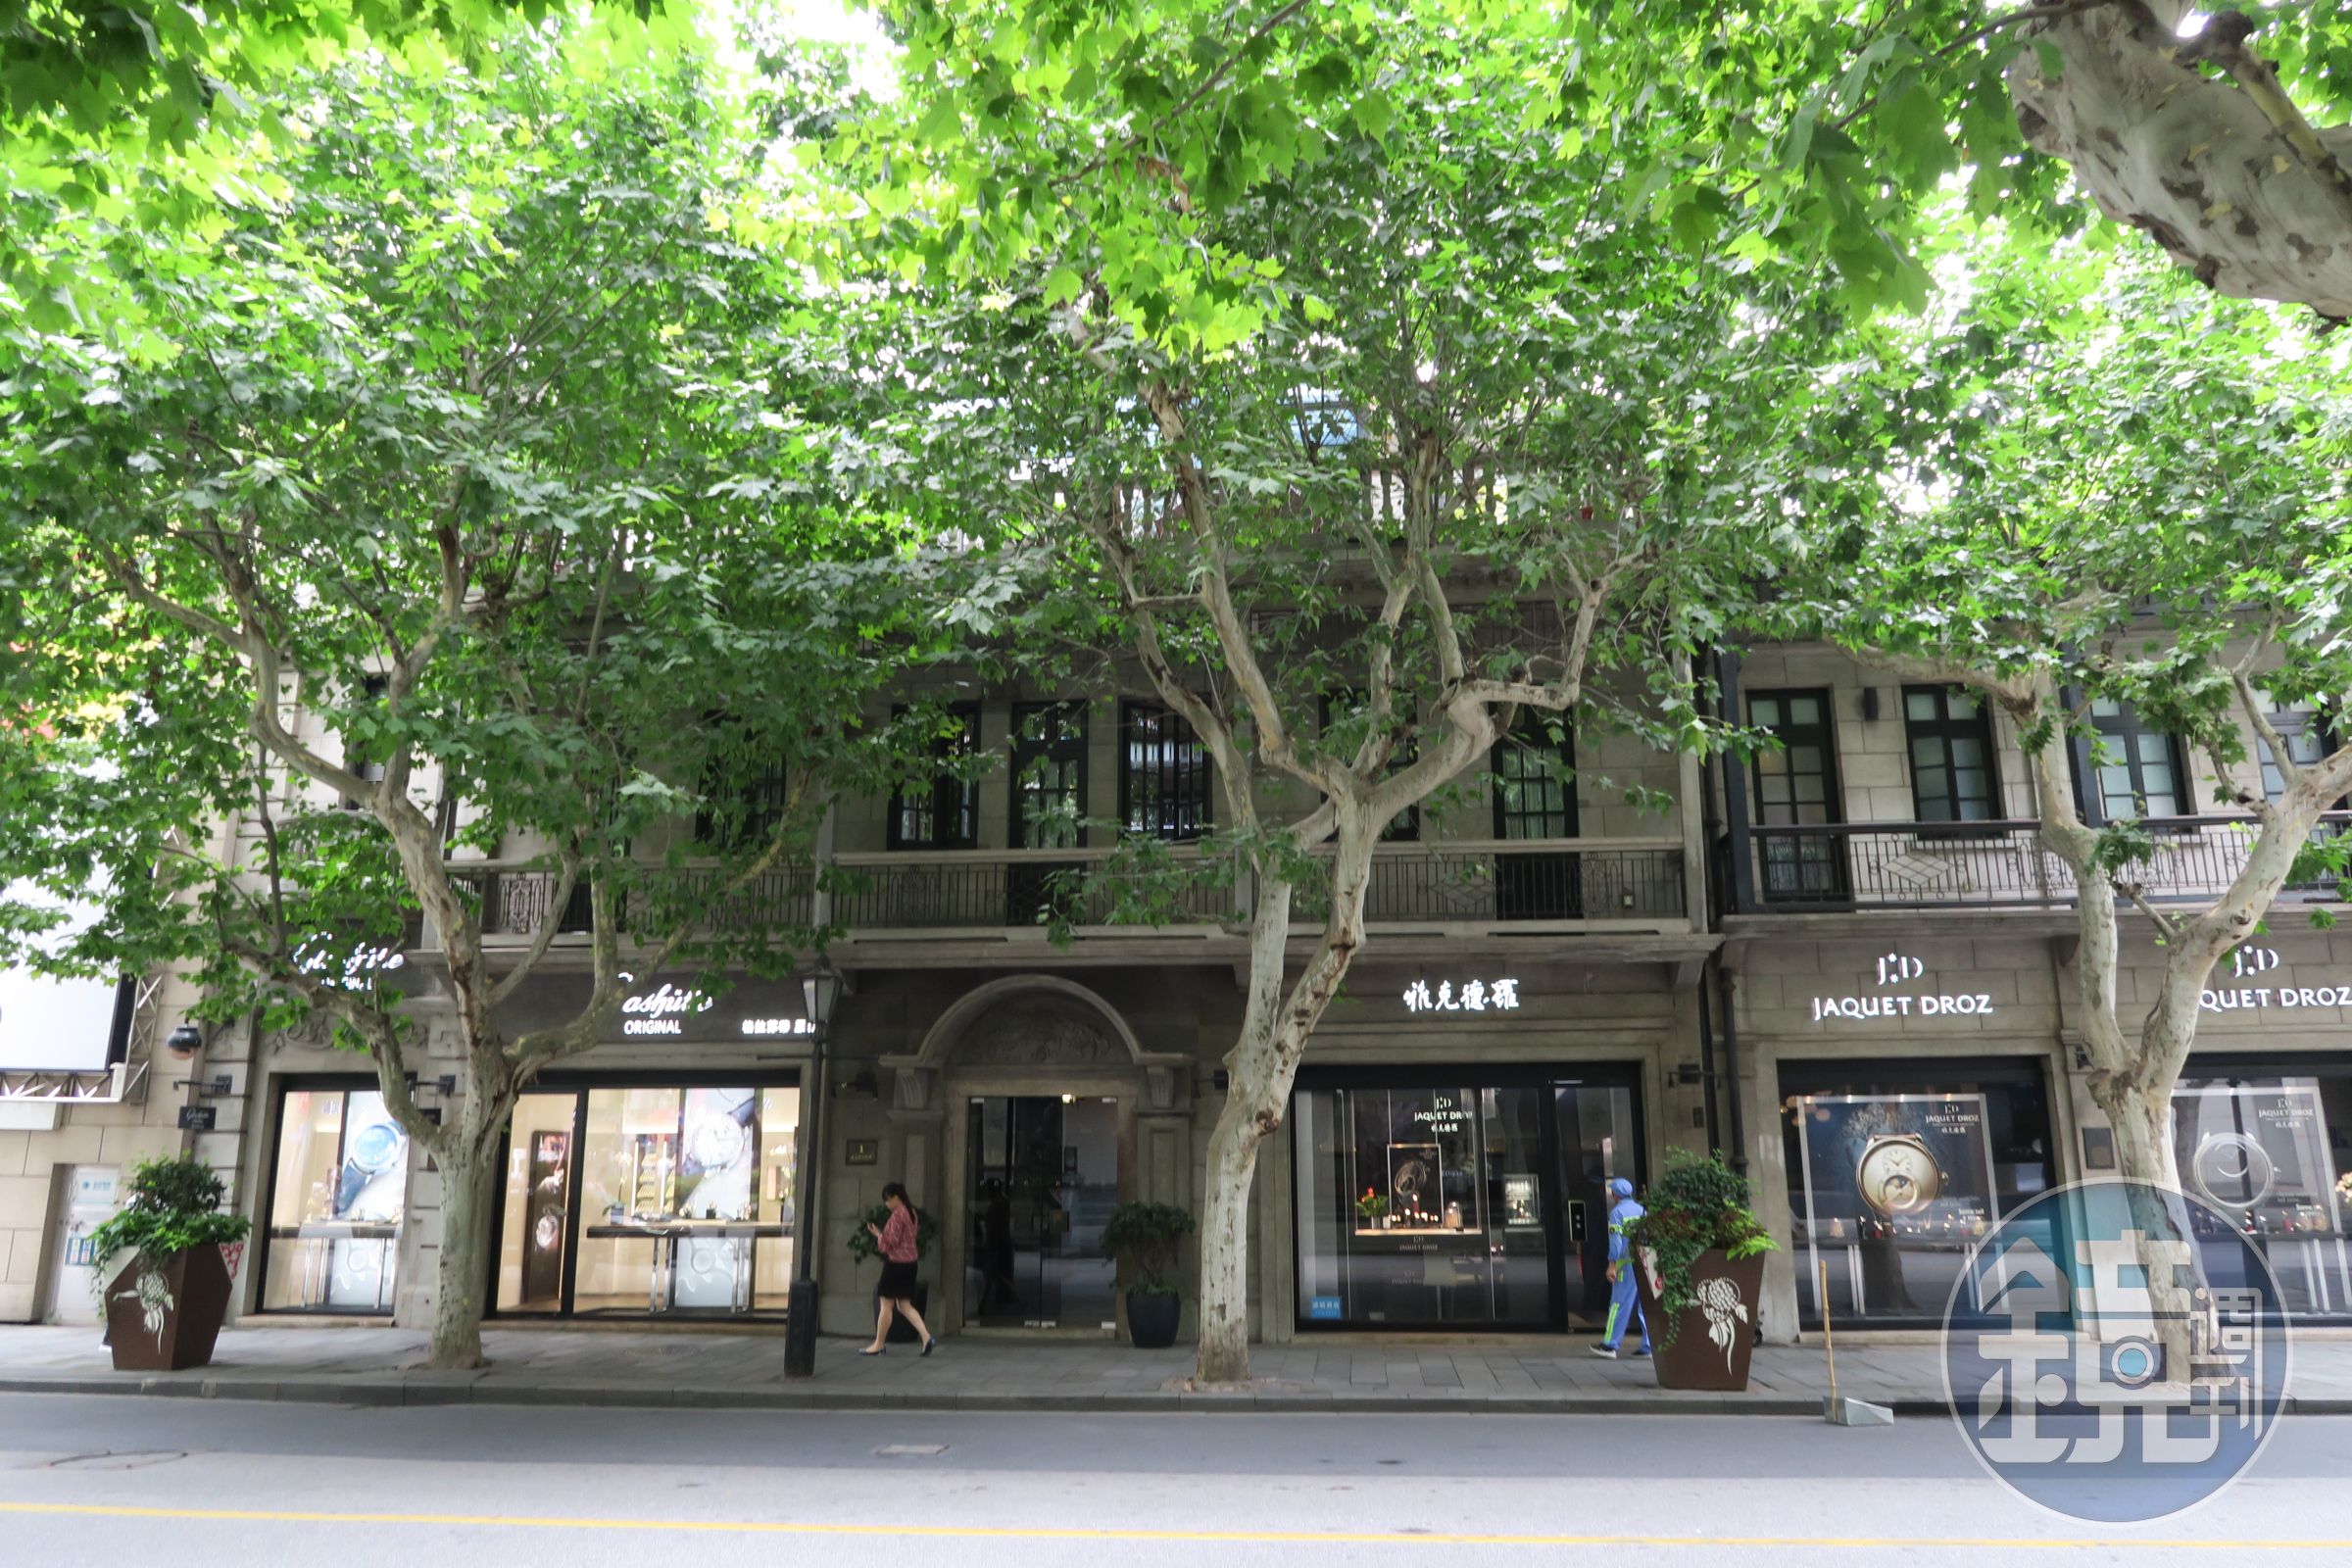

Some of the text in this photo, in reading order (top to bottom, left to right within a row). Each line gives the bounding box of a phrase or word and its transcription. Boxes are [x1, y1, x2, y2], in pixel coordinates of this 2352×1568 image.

[2198, 986, 2352, 1013] QUET DROZ
[1813, 995, 1993, 1021] JAQUET DROZ
[623, 1019, 682, 1035] ORIGINAL
[1414, 1111, 1448, 1122] JAQUET
[1925, 1114, 1955, 1124] JAQUET
